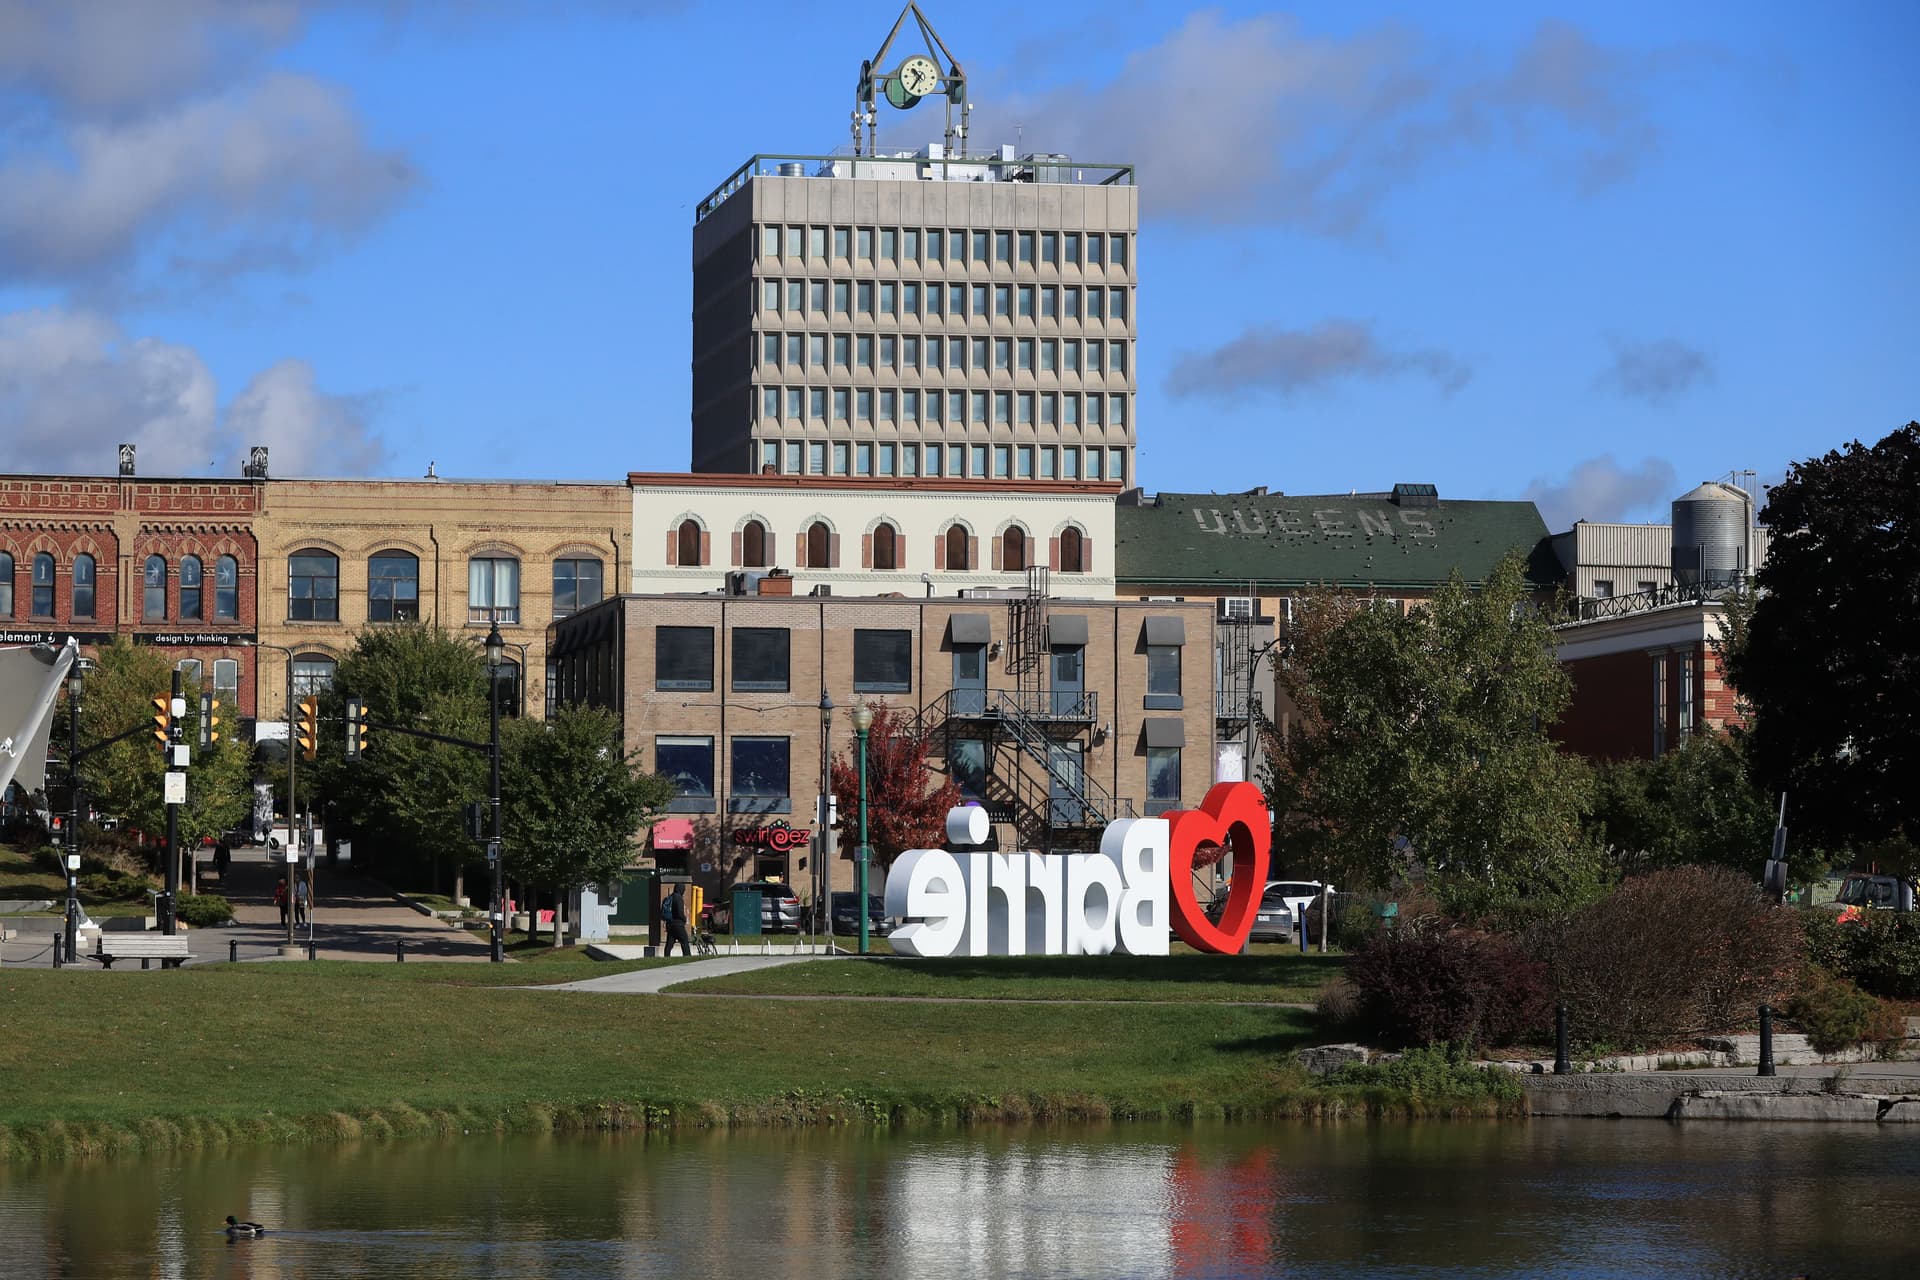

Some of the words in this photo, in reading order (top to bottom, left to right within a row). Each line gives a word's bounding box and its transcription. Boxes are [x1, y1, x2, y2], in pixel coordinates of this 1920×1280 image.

[0, 494, 109, 509] ANDERS
[148, 496, 248, 510] BLOCK
[1192, 508, 1437, 538] QUEENS
[0, 628, 42, 642] element
[155, 633, 182, 644] design
[184, 633, 195, 644] by
[196, 633, 228, 644] thinking
